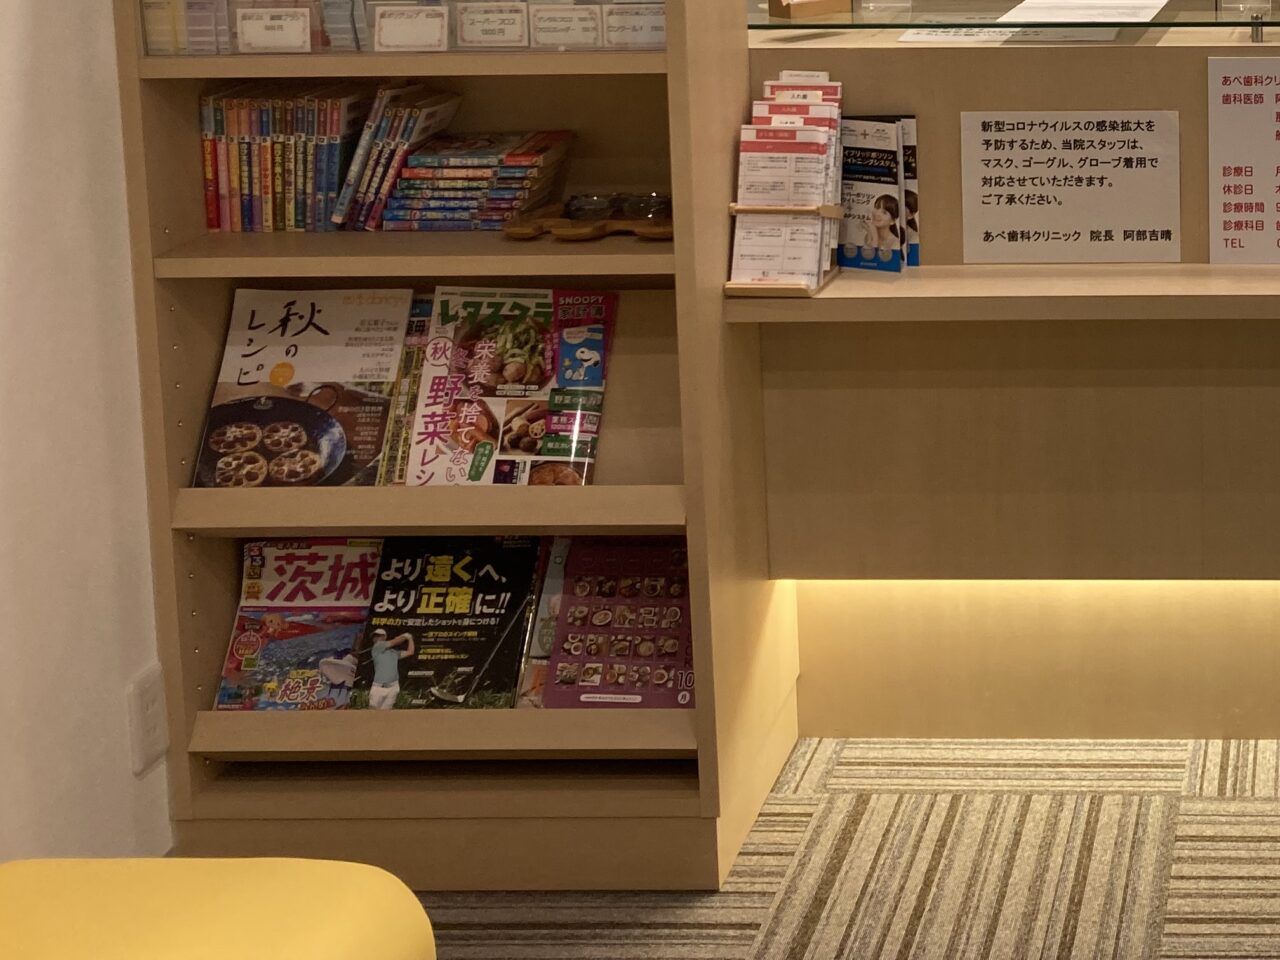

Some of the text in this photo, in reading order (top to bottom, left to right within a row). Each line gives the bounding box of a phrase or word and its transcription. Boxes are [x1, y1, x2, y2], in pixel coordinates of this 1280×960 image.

[1222, 93, 1264, 105] 歯科医師
[981, 120, 1156, 133] 新型コロナウイルスの感染拡大を
[981, 139, 1144, 151] 予防するため、当院スタッフは、
[981, 157, 1159, 169] マスク、ゴーグル、グローブ着用で
[1222, 165, 1254, 177] 診療日
[981, 176, 1114, 188] 対応させていただきます。
[1222, 184, 1254, 195] 休診日
[981, 194, 1063, 206] ご了承ください。
[1222, 202, 1265, 214] 診療時間
[1222, 220, 1264, 231] 診療科目
[983, 229, 1172, 242] あべ歯科クリニック 院長 阿部吉晴
[1223, 238, 1245, 249] TEL
[559, 296, 604, 305] SNOOPY
[237, 309, 268, 386] レシピ
[265, 551, 379, 602] 茨城
[677, 670, 695, 690] 10
